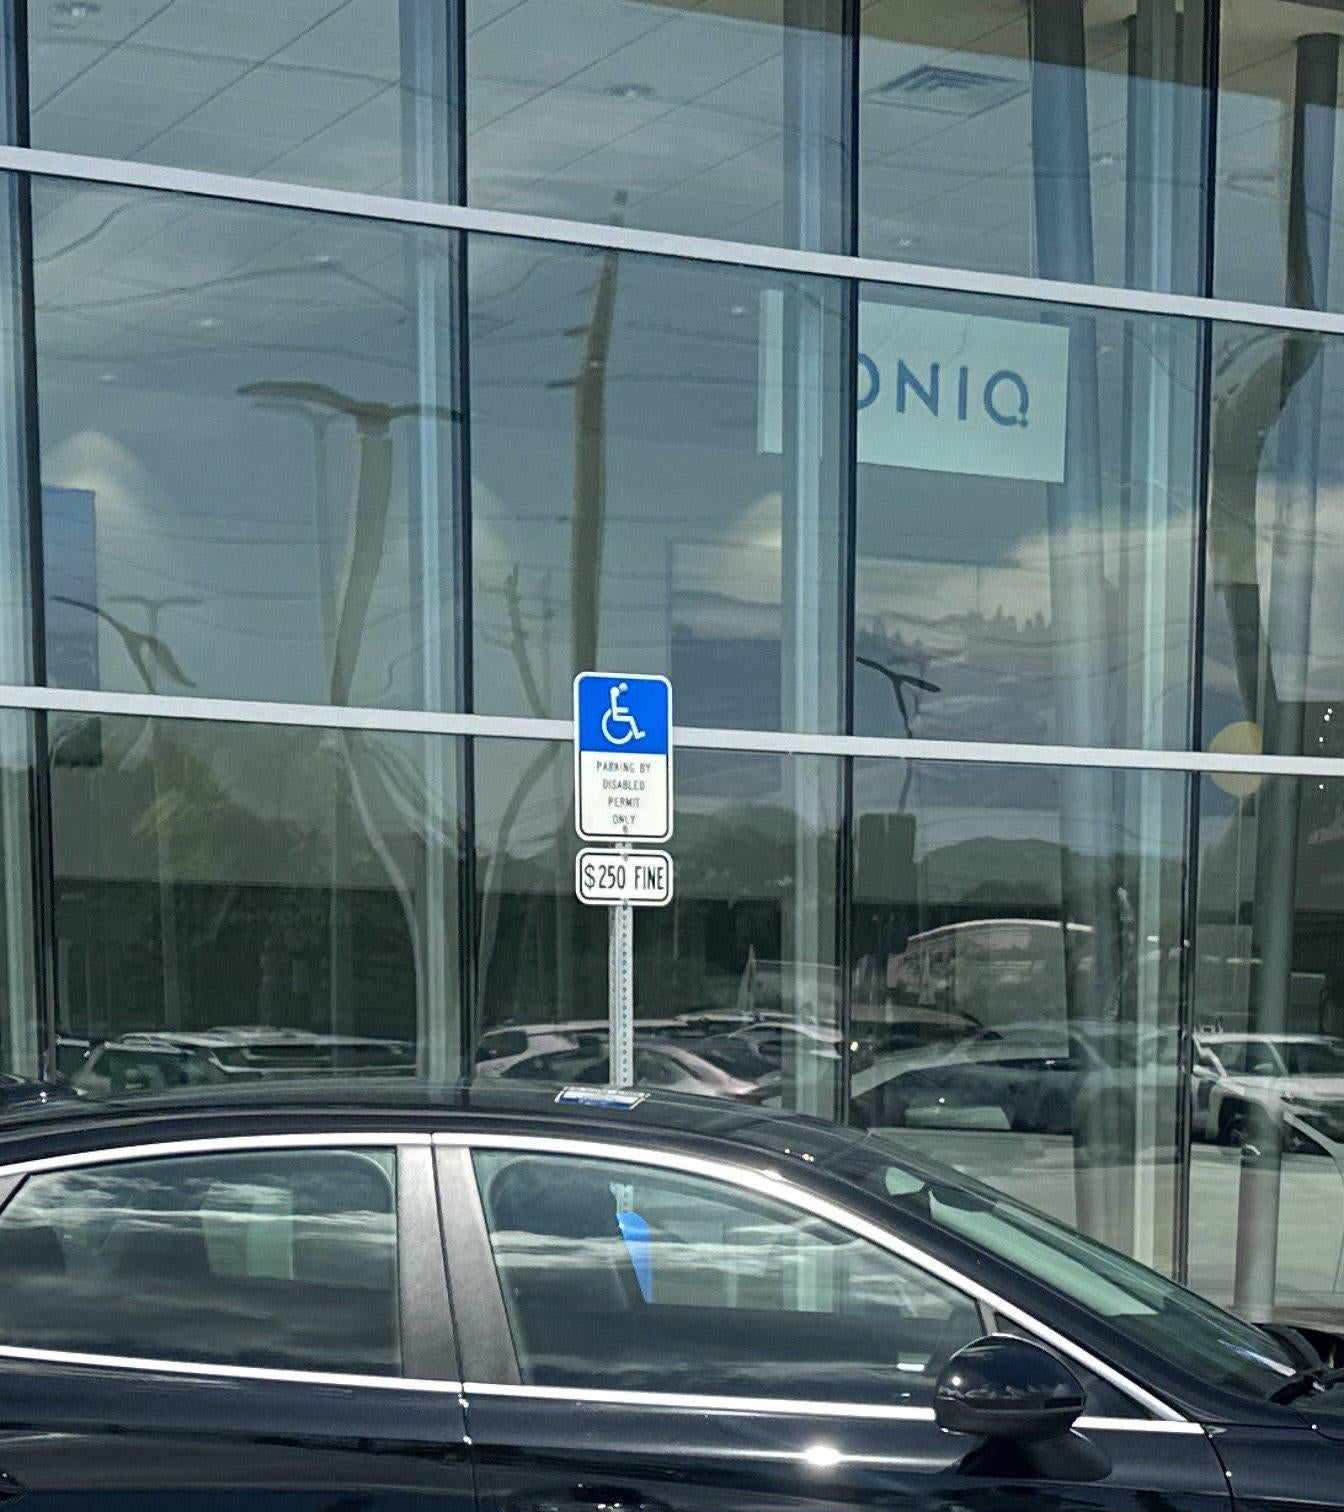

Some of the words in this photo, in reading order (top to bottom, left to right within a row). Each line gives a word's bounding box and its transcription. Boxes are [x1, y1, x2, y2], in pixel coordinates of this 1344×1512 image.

[856, 352, 1030, 428] ONIQ
[596, 761, 635, 773] PARKING
[639, 762, 651, 774] BY
[602, 779, 645, 791] DISABLED
[608, 796, 640, 808] PERMIT
[613, 814, 636, 825] ONLY
[584, 863, 626, 891] $250
[634, 865, 665, 891] FINE
